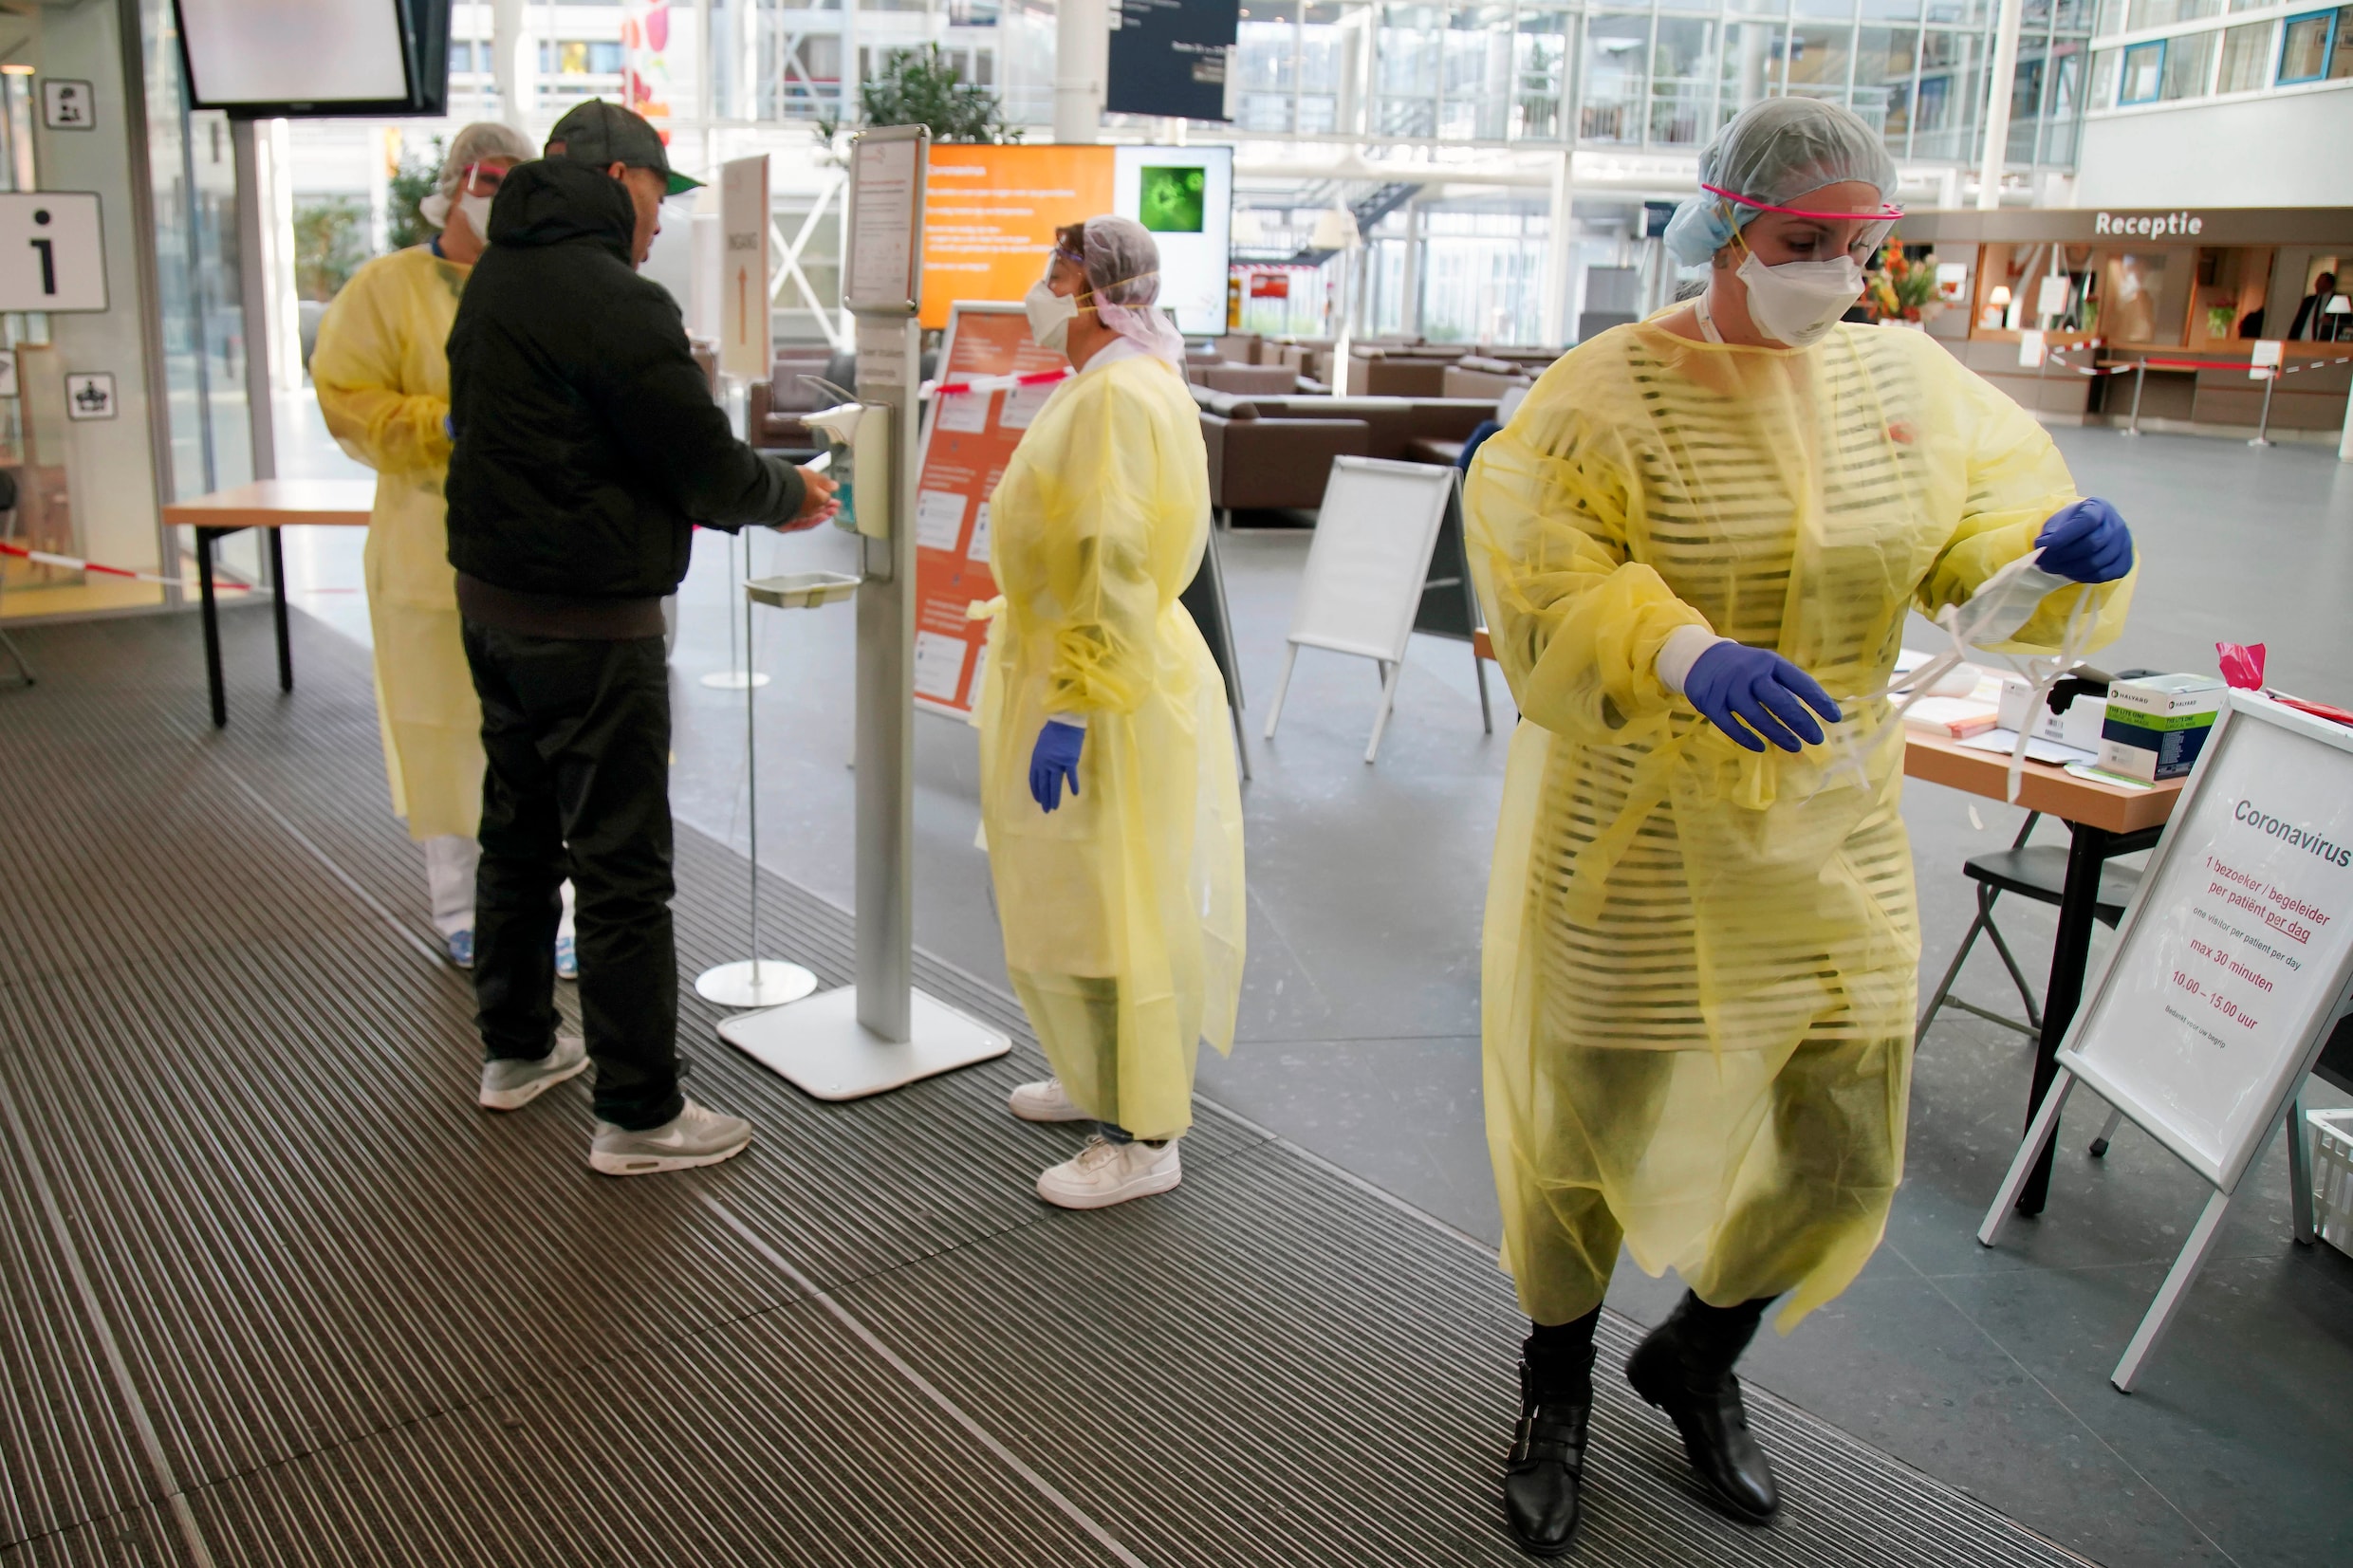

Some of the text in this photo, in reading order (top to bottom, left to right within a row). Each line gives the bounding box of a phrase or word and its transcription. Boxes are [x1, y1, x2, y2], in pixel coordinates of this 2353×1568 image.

[2095, 212, 2203, 240] Receptie
[2120, 693, 2149, 704] HALYARD
[2234, 800, 2352, 868] Coronavirus
[2206, 856, 2331, 926] 1 bezoeker / begeleider
[2209, 881, 2311, 944] per patiënt per dag
[2190, 939, 2273, 993] max 30 minuten
[2193, 907, 2302, 971] one visitor per patient per day
[2165, 1005, 2226, 1049] Bedankt voor uw begrip
[2173, 970, 2200, 994] 10.00
[2209, 992, 2238, 1018] 15.00
[2237, 1012, 2258, 1030] uur
